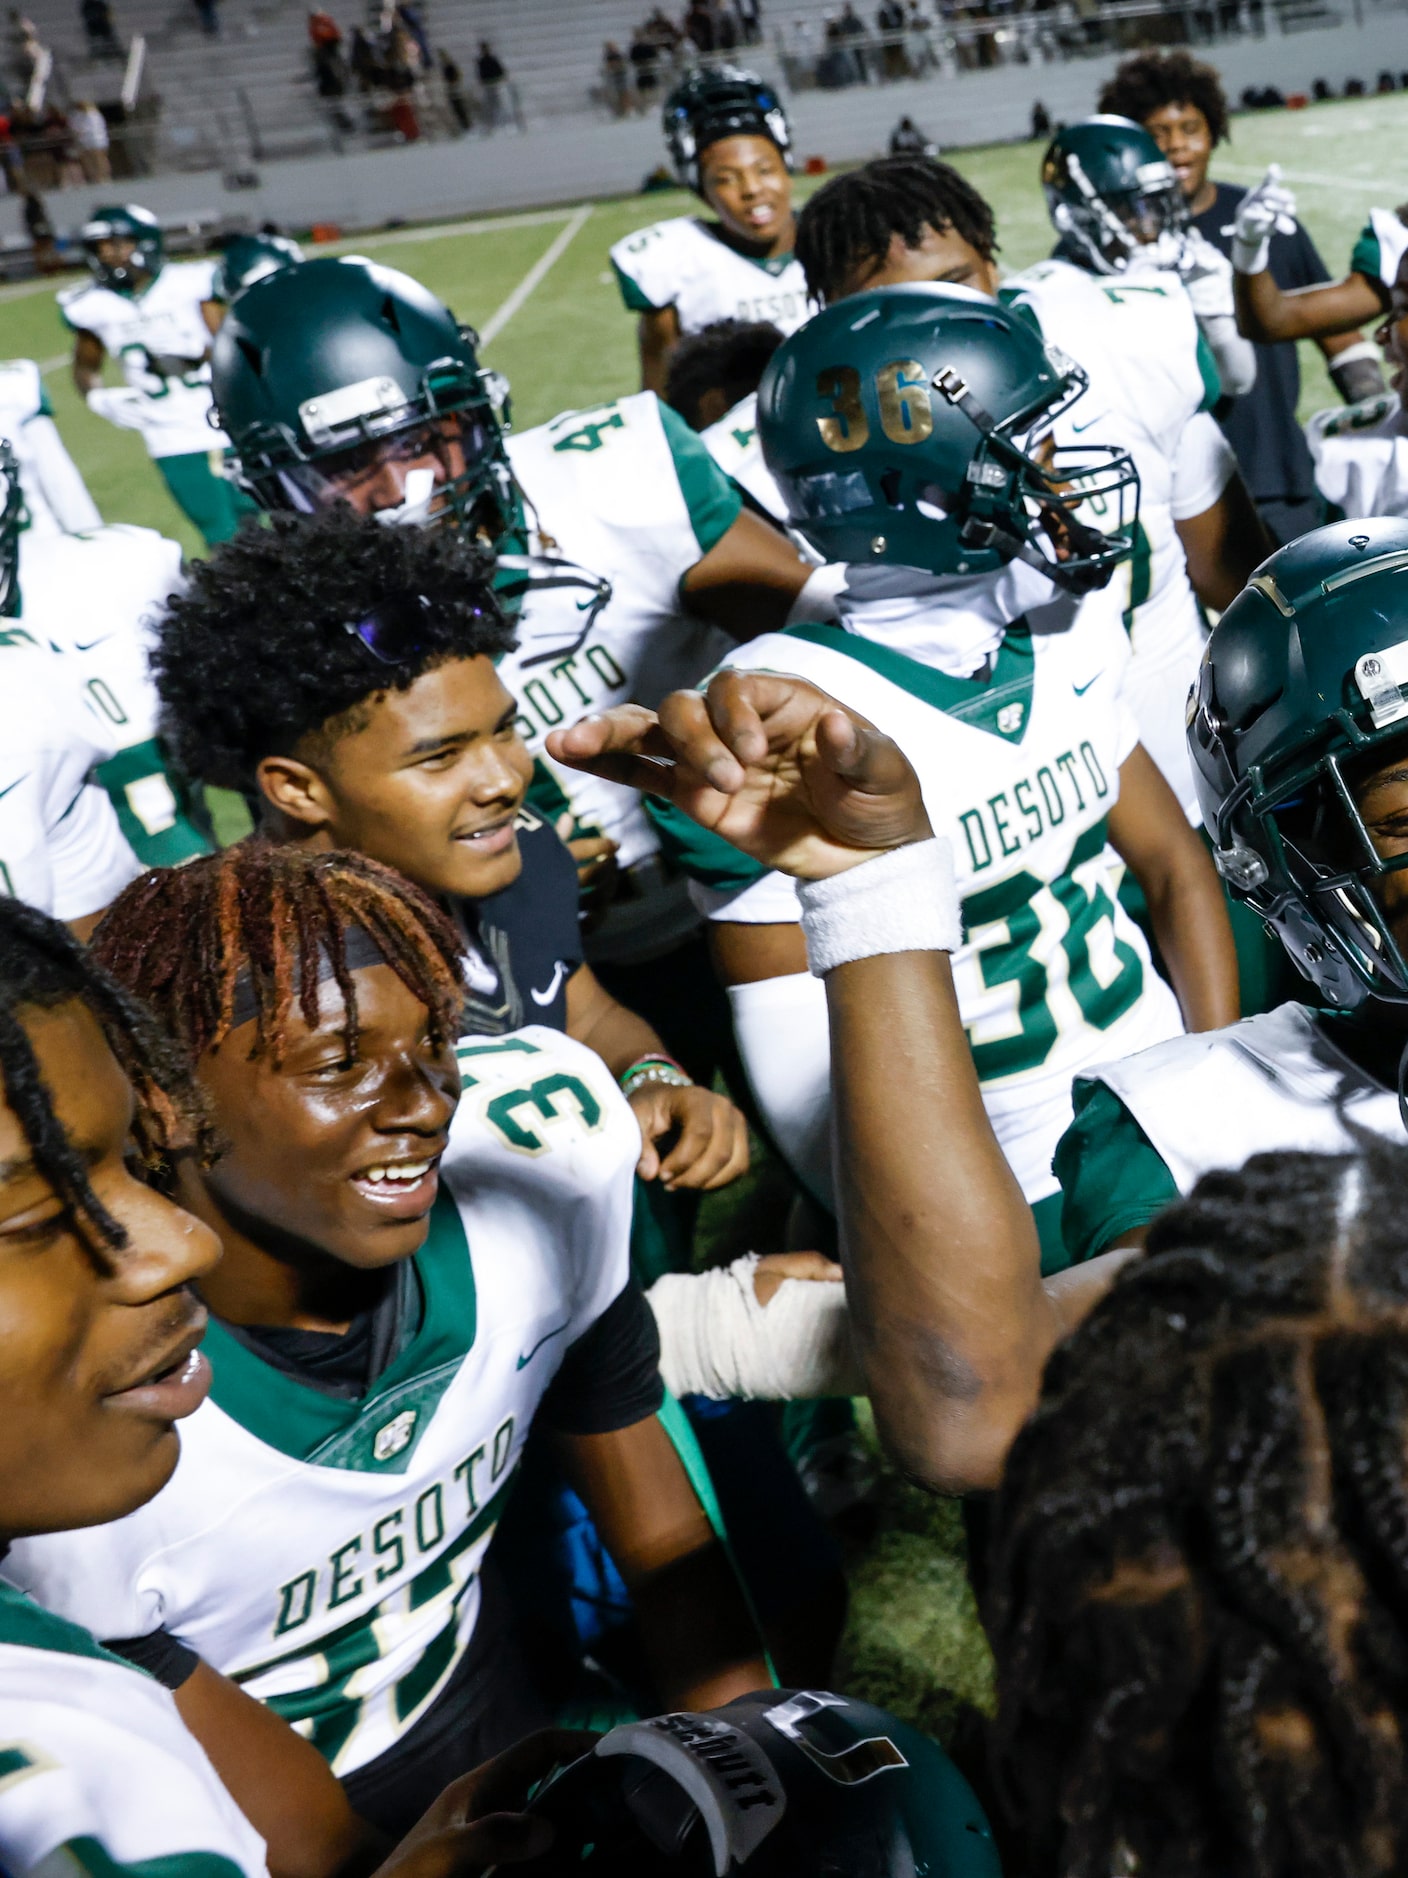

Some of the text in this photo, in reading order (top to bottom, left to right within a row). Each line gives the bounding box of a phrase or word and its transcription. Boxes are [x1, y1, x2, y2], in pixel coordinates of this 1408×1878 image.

[815, 360, 934, 453] 36
[958, 740, 1109, 874] DESOTO
[272, 1416, 516, 1640] DESOTO
